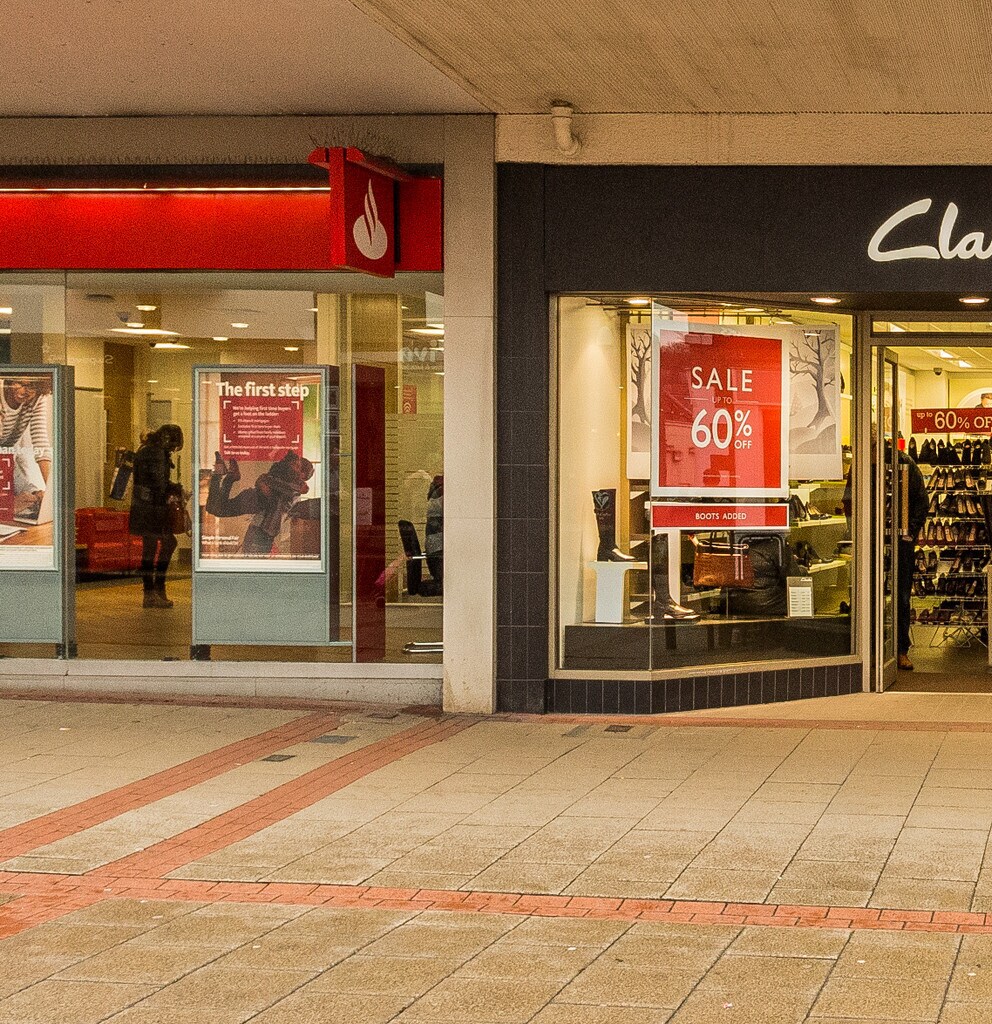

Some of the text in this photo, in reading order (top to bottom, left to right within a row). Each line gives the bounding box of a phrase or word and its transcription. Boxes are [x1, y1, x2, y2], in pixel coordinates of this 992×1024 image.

[691, 366, 753, 392] SALE
[216, 381, 310, 401] The first step
[711, 396, 733, 404] UP TO
[691, 408, 753, 449] 60% OFF
[934, 411, 970, 429] 60%
[695, 512, 747, 520] BOOTS ADDED
